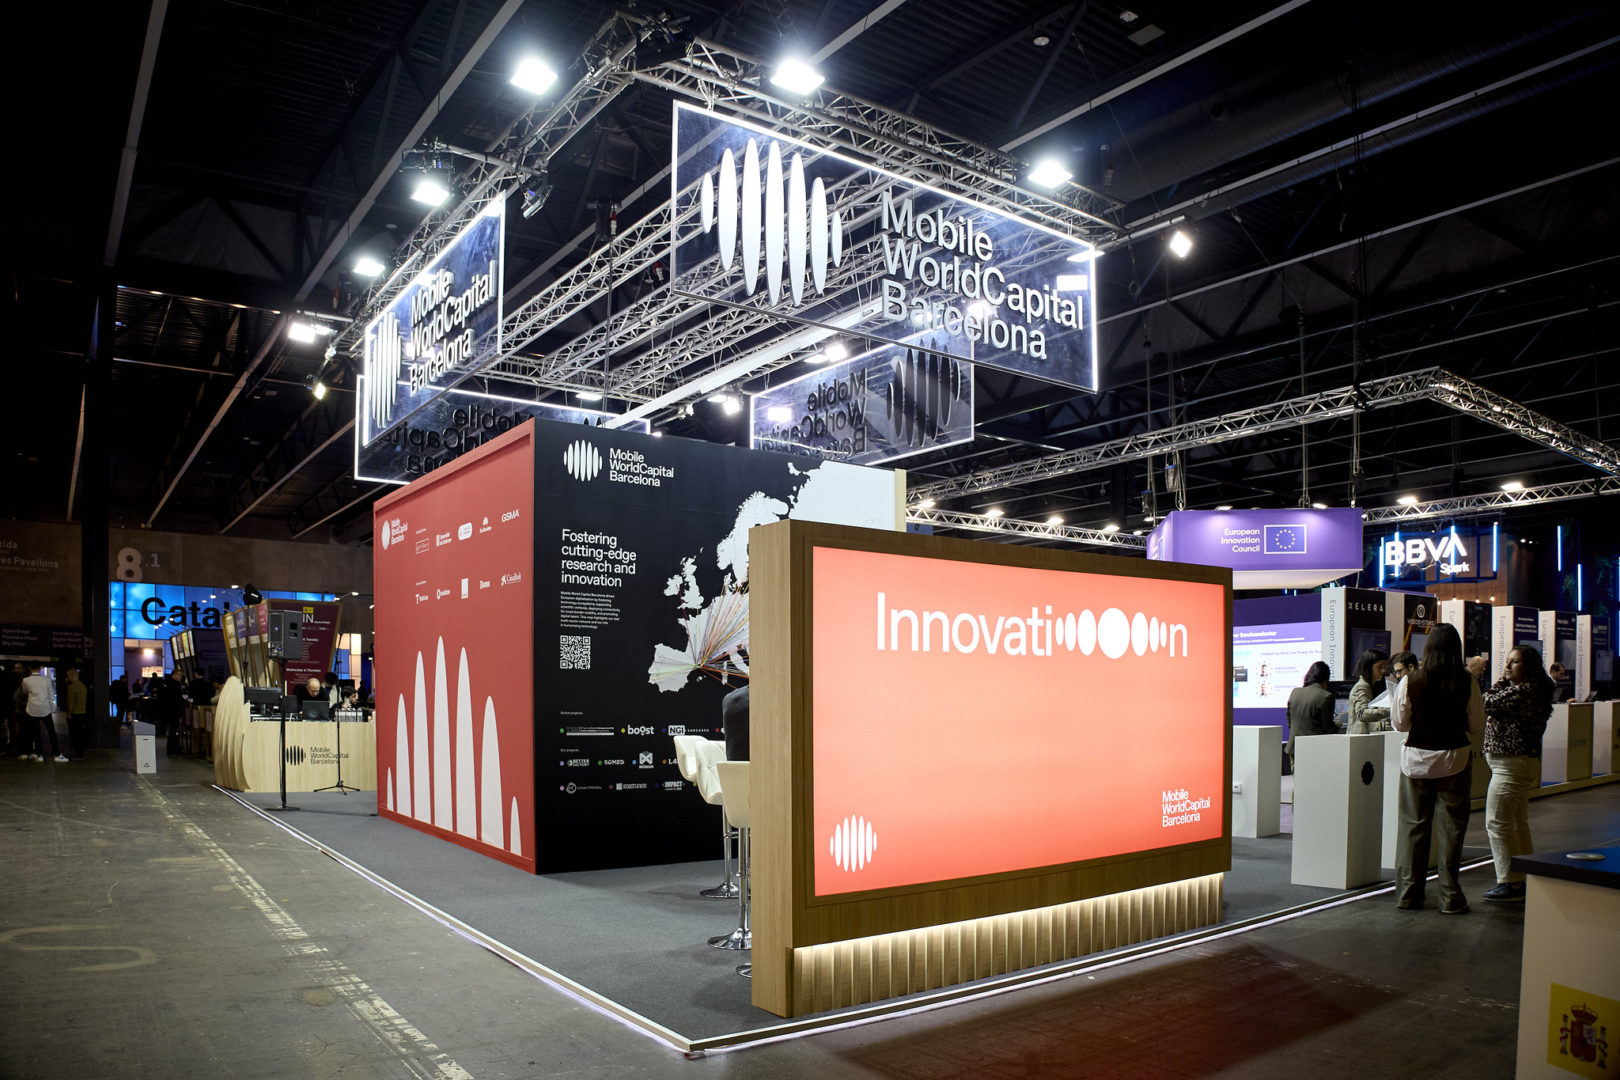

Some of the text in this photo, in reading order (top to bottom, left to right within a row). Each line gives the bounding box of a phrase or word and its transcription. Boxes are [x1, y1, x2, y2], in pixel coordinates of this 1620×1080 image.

[881, 190, 993, 262] Mobile
[881, 234, 1083, 330] WorldCapital
[411, 268, 454, 328] Mobile
[411, 260, 497, 361] WorldCapital
[881, 278, 1047, 360] Barcelona
[408, 328, 475, 397] Barcelona
[610, 448, 645, 463] Mobile
[609, 459, 674, 478] WorldCapital
[610, 470, 661, 487] Barcelona
[501, 509, 520, 522] GSMA
[562, 528, 618, 549] Fostering
[1221, 536, 1260, 545] Innovation
[1224, 528, 1260, 537] European
[561, 545, 637, 564] cutting-edge
[1232, 545, 1261, 553] Council
[1385, 533, 1468, 566] BBVA
[13, 556, 59, 569] Pavellons
[561, 559, 636, 575] research and
[1440, 562, 1470, 576] Spark
[561, 571, 622, 587] innovation
[1329, 599, 1337, 642] European
[627, 724, 655, 736] boost
[669, 726, 685, 735] NGI
[1162, 788, 1189, 803] Mobile
[1162, 796, 1211, 815] WorldCapital
[1162, 812, 1201, 828] Barcelona
